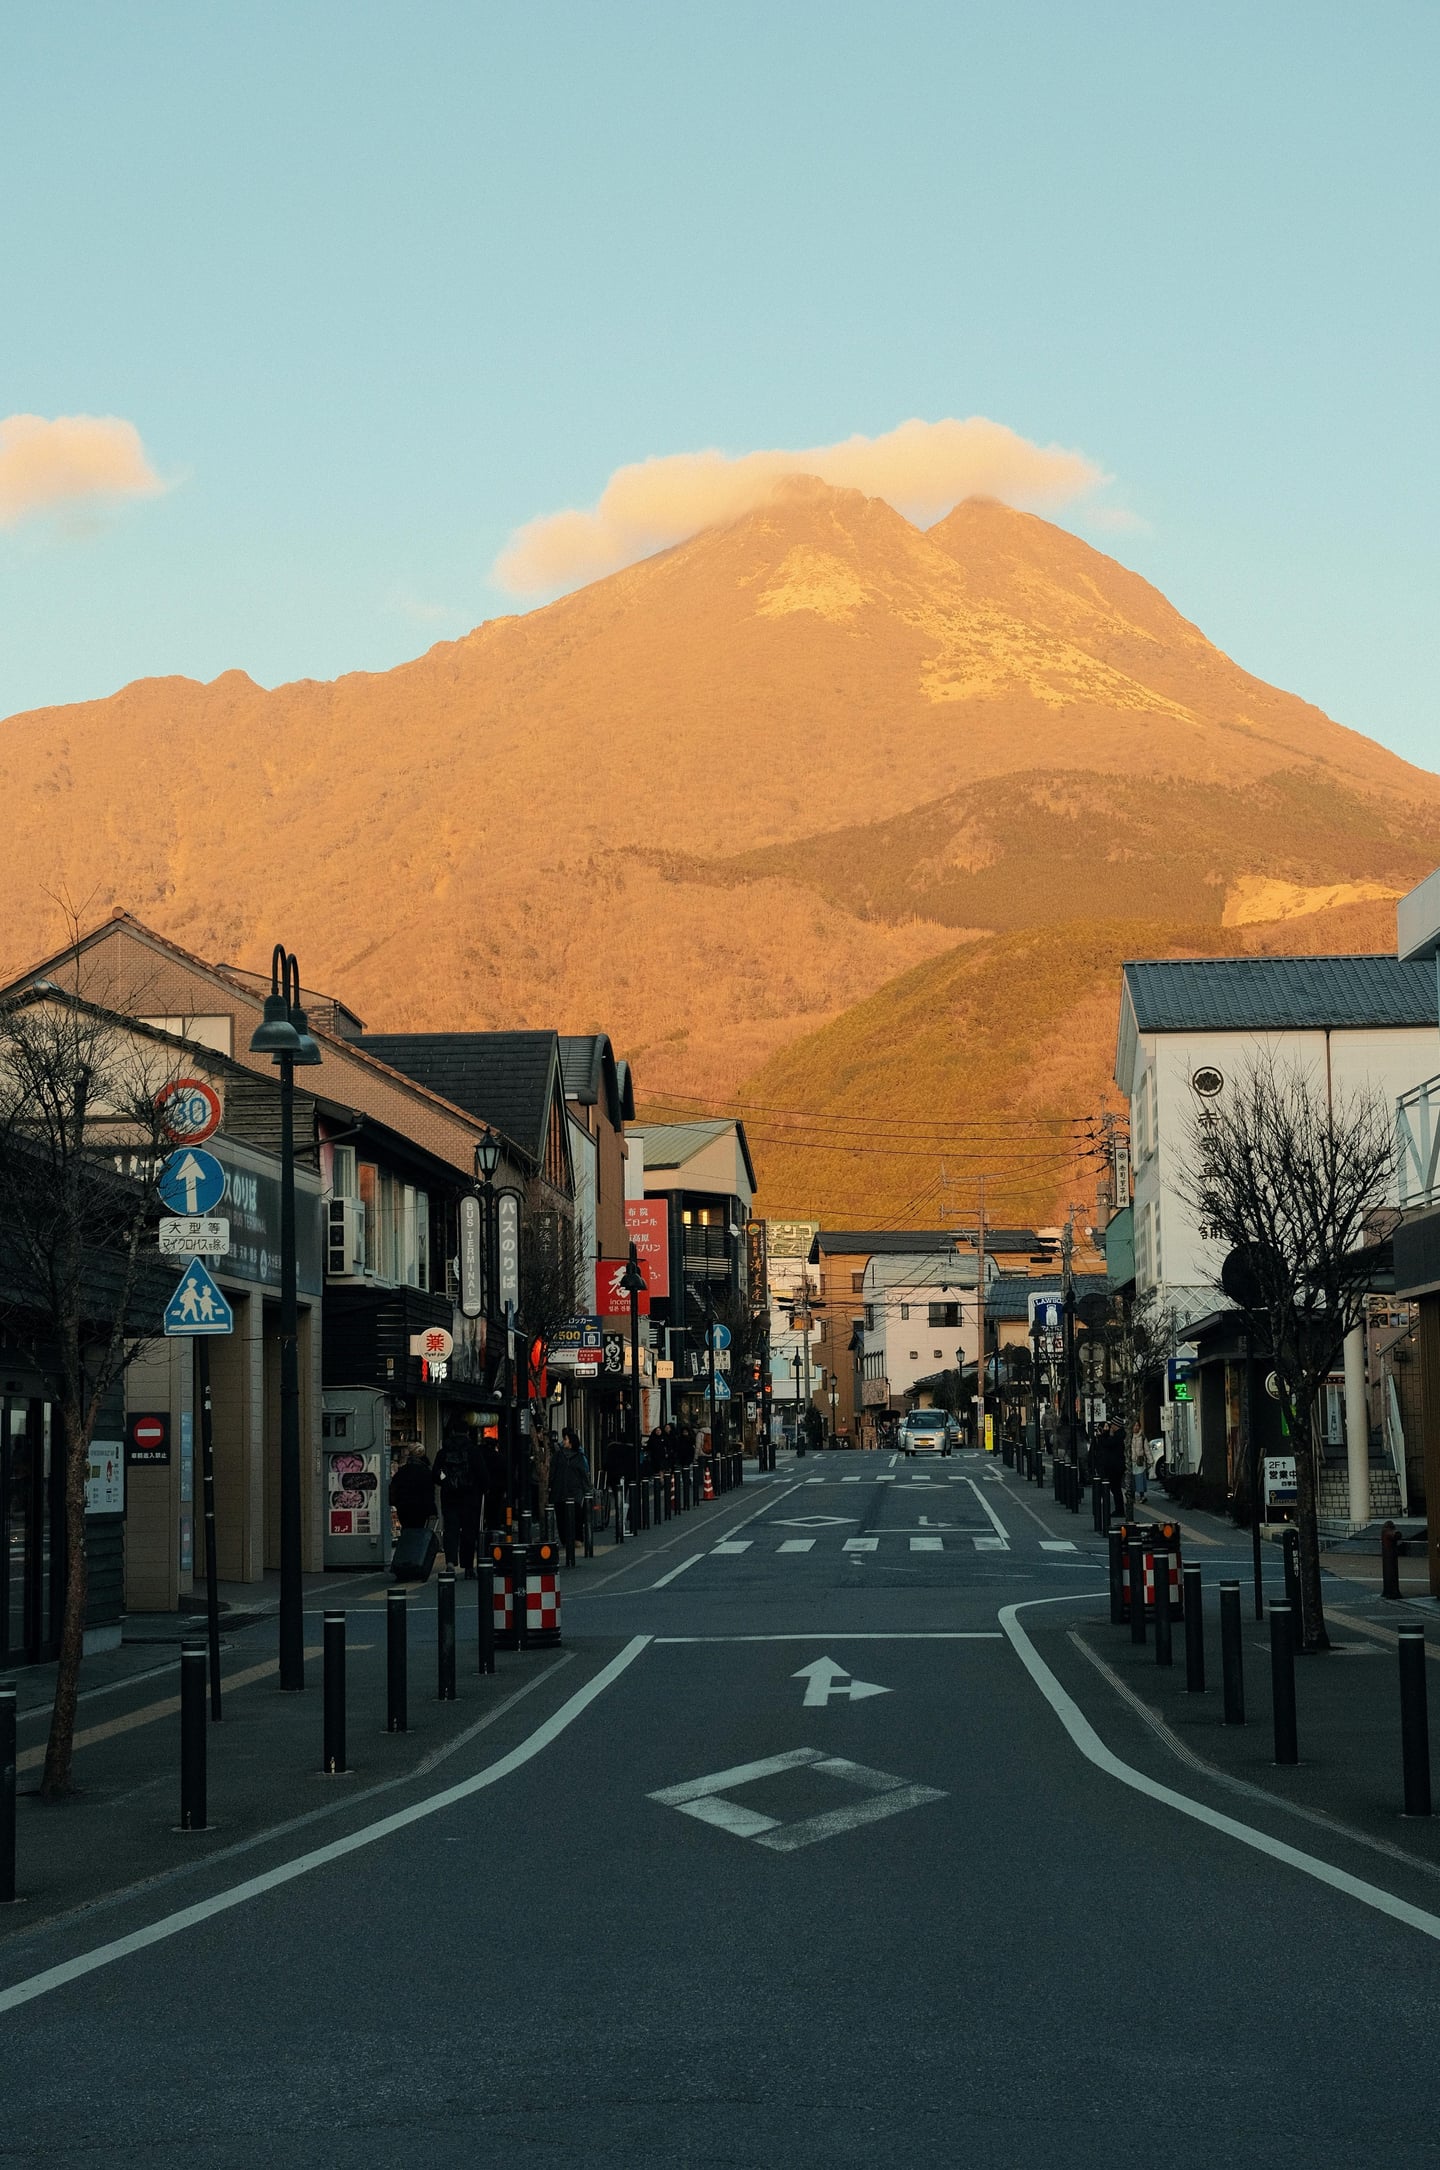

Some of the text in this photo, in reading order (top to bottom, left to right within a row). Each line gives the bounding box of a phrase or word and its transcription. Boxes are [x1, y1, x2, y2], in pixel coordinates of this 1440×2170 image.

[172, 1098, 206, 1126] 30
[466, 1203, 475, 1227] BUS
[168, 1222, 221, 1235] 大型等
[501, 1203, 516, 1289] バスのりば
[466, 1231, 476, 1297] TERMINAL
[1035, 1297, 1063, 1306] LAWSO
[1269, 1461, 1281, 1469] 2F
[1269, 1470, 1298, 1480] 営業中
